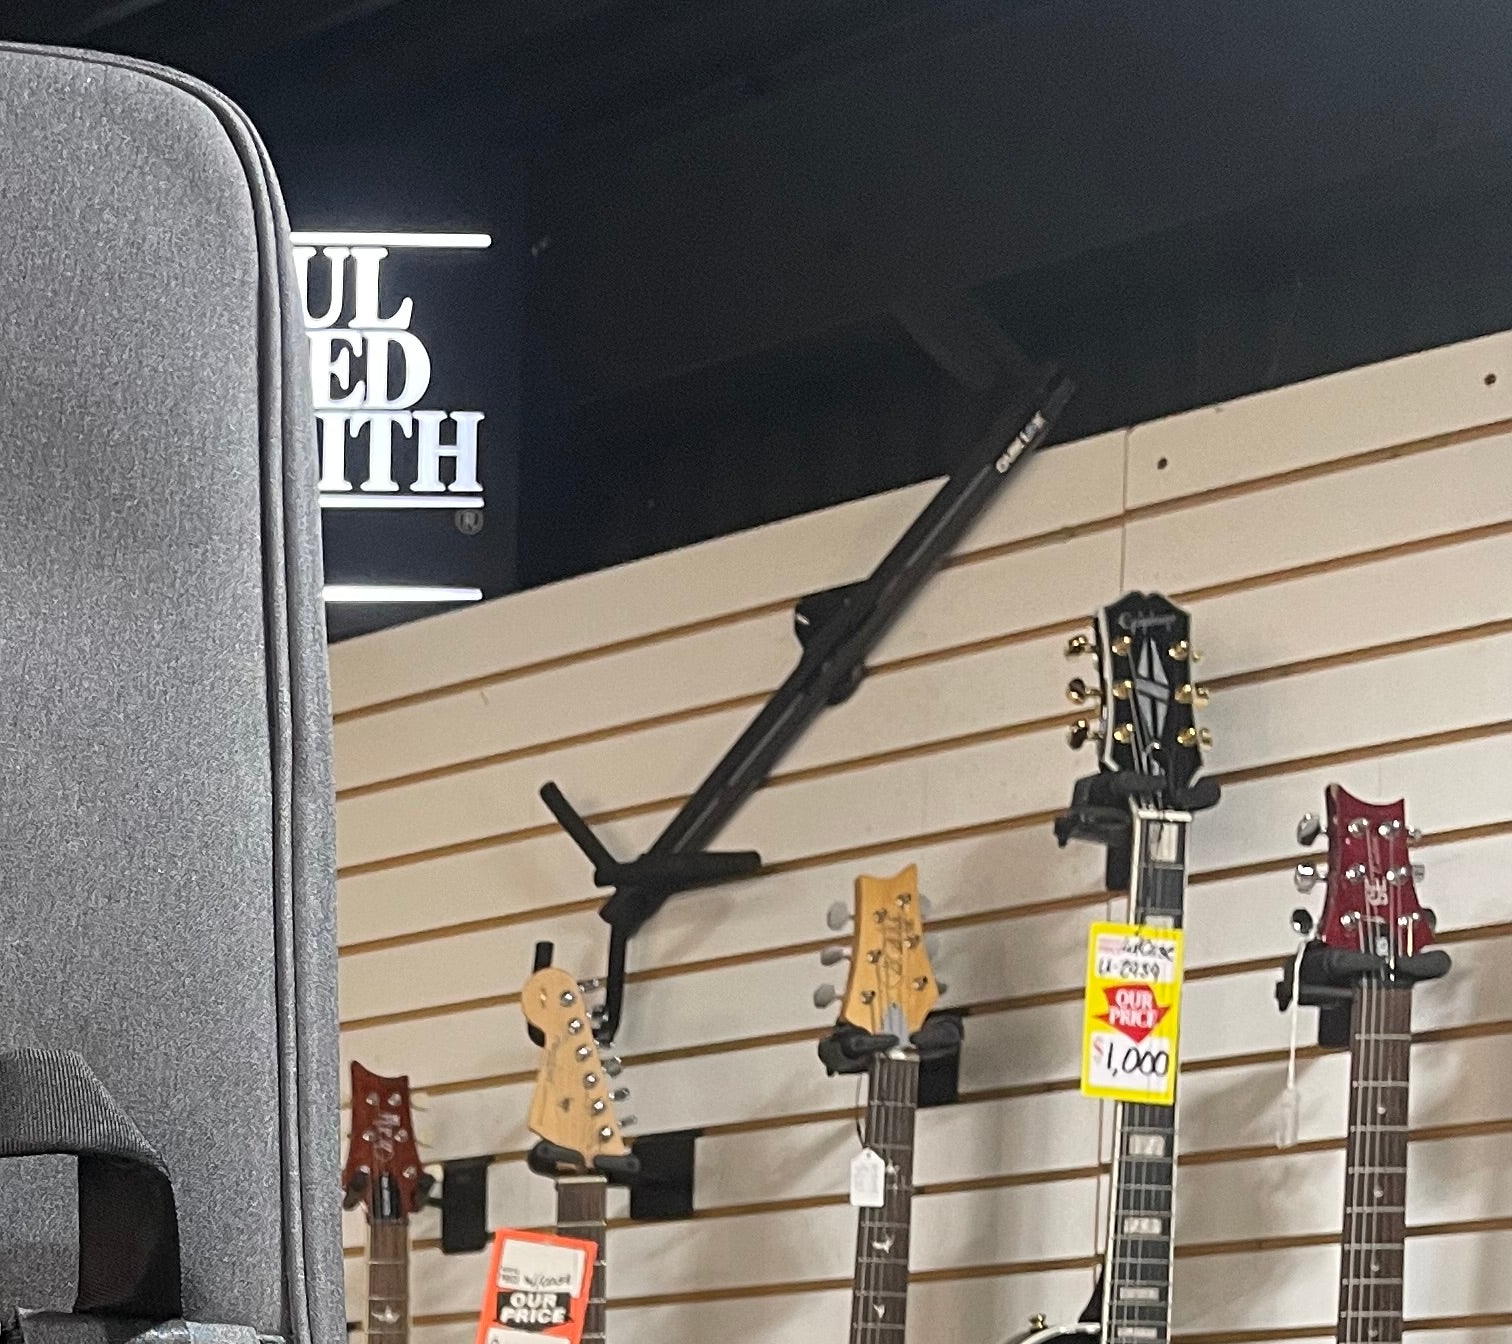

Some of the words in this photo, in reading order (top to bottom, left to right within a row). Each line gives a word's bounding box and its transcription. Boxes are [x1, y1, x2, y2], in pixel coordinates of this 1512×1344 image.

[291, 246, 413, 330] UL
[306, 328, 431, 410] ED
[314, 409, 485, 492] ITH
[1114, 988, 1154, 1010] OUR
[1108, 1005, 1159, 1028] PRICE
[509, 1291, 558, 1309] OUR
[500, 1306, 567, 1324] PRICE
